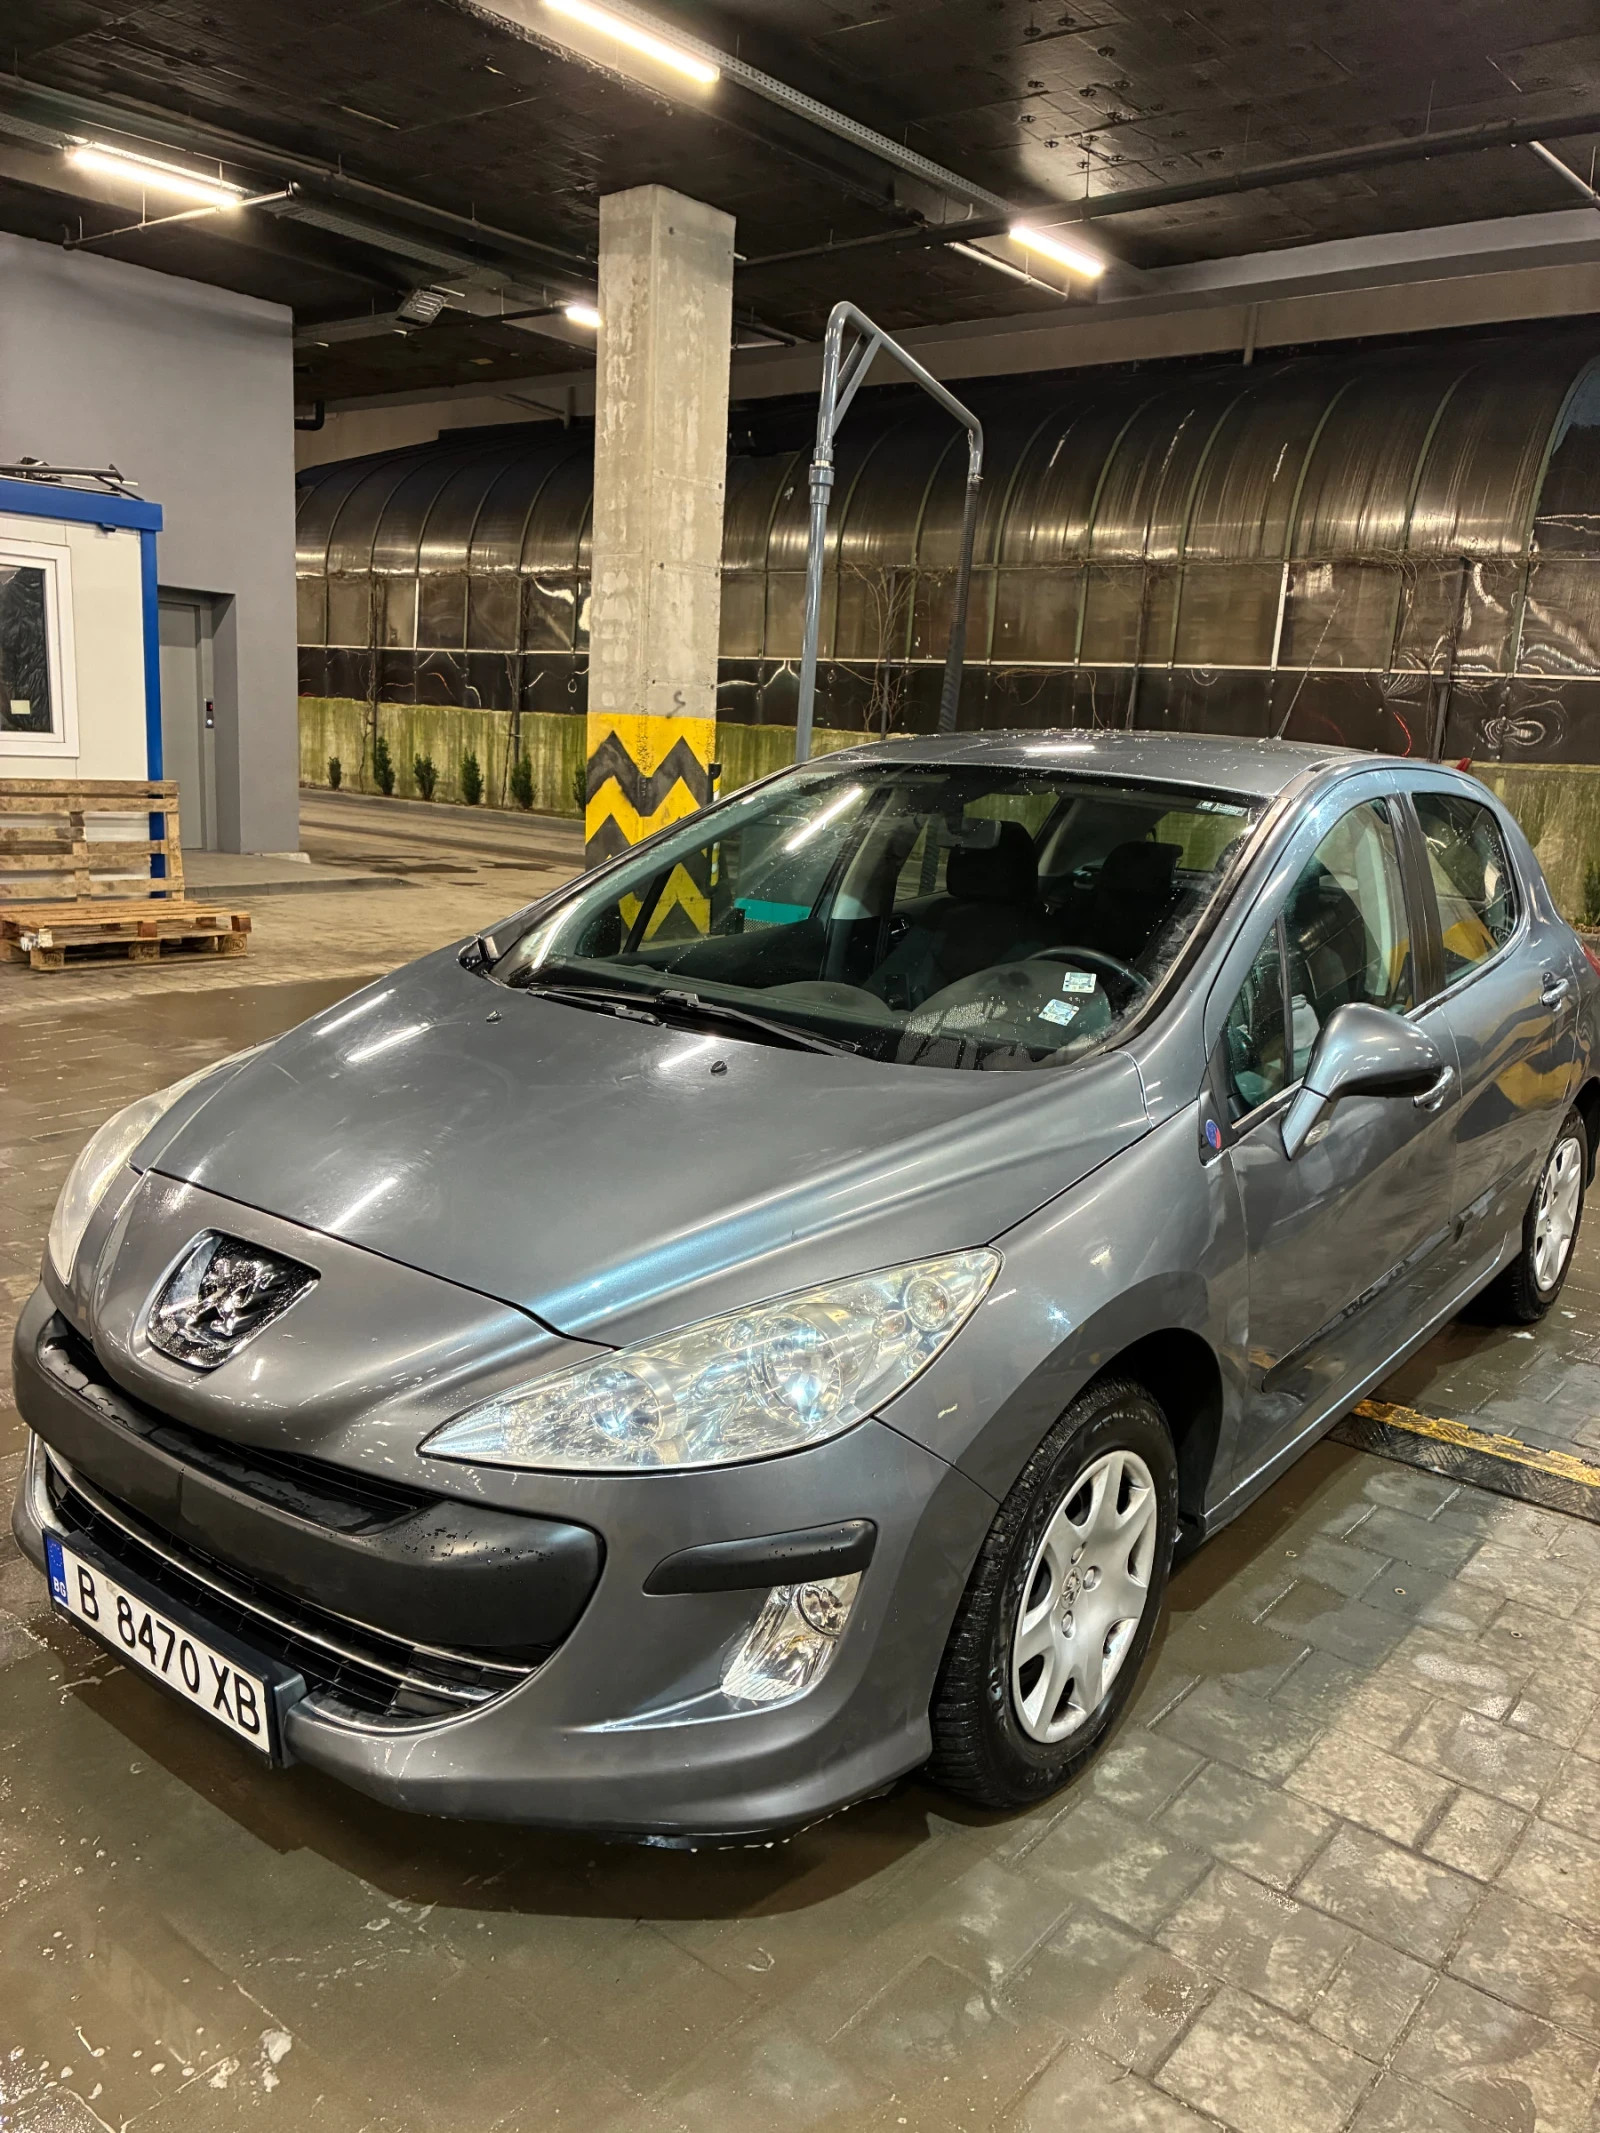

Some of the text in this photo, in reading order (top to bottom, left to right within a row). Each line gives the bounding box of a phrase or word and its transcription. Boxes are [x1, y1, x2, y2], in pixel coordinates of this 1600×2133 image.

[53, 1576, 67, 1598] BG
[77, 1564, 260, 1735] B 8470 XB
